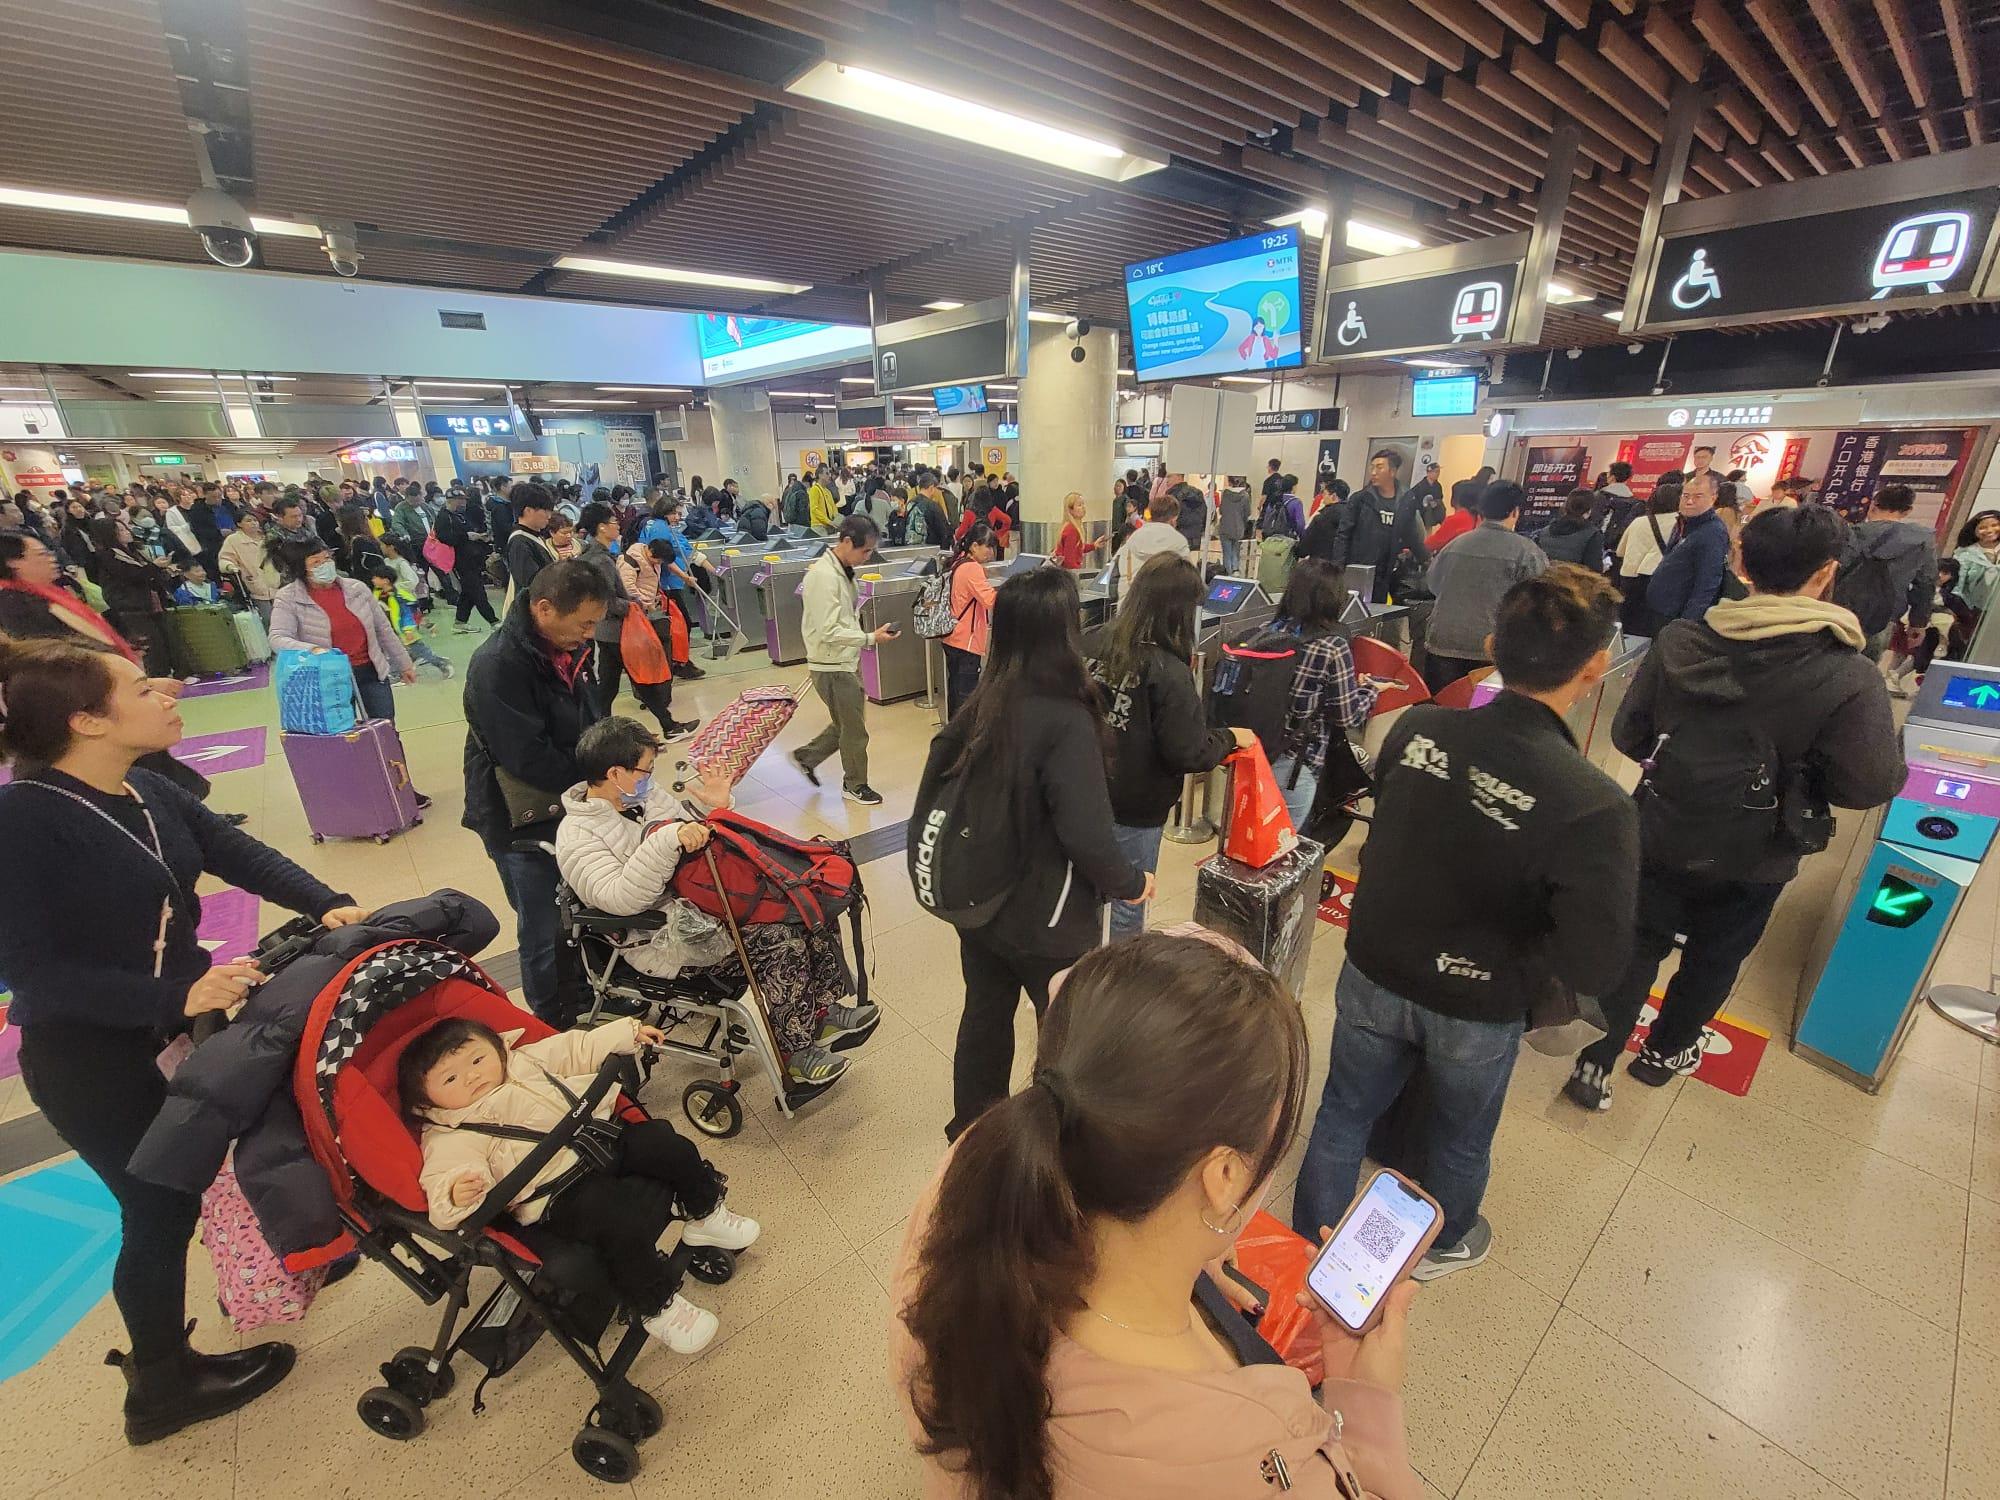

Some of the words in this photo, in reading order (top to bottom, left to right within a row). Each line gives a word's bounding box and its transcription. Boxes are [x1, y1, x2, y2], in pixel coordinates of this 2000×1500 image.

[1261, 234, 1288, 249] 19:25
[1276, 256, 1293, 265] MTR
[1146, 262, 1164, 275] 18°C
[1185, 335, 1200, 344] might
[1850, 435, 1880, 492] 香港银行
[1822, 436, 1857, 507] 户口开户安
[915, 809, 946, 907] adidas
[1316, 903, 1349, 919] ority
